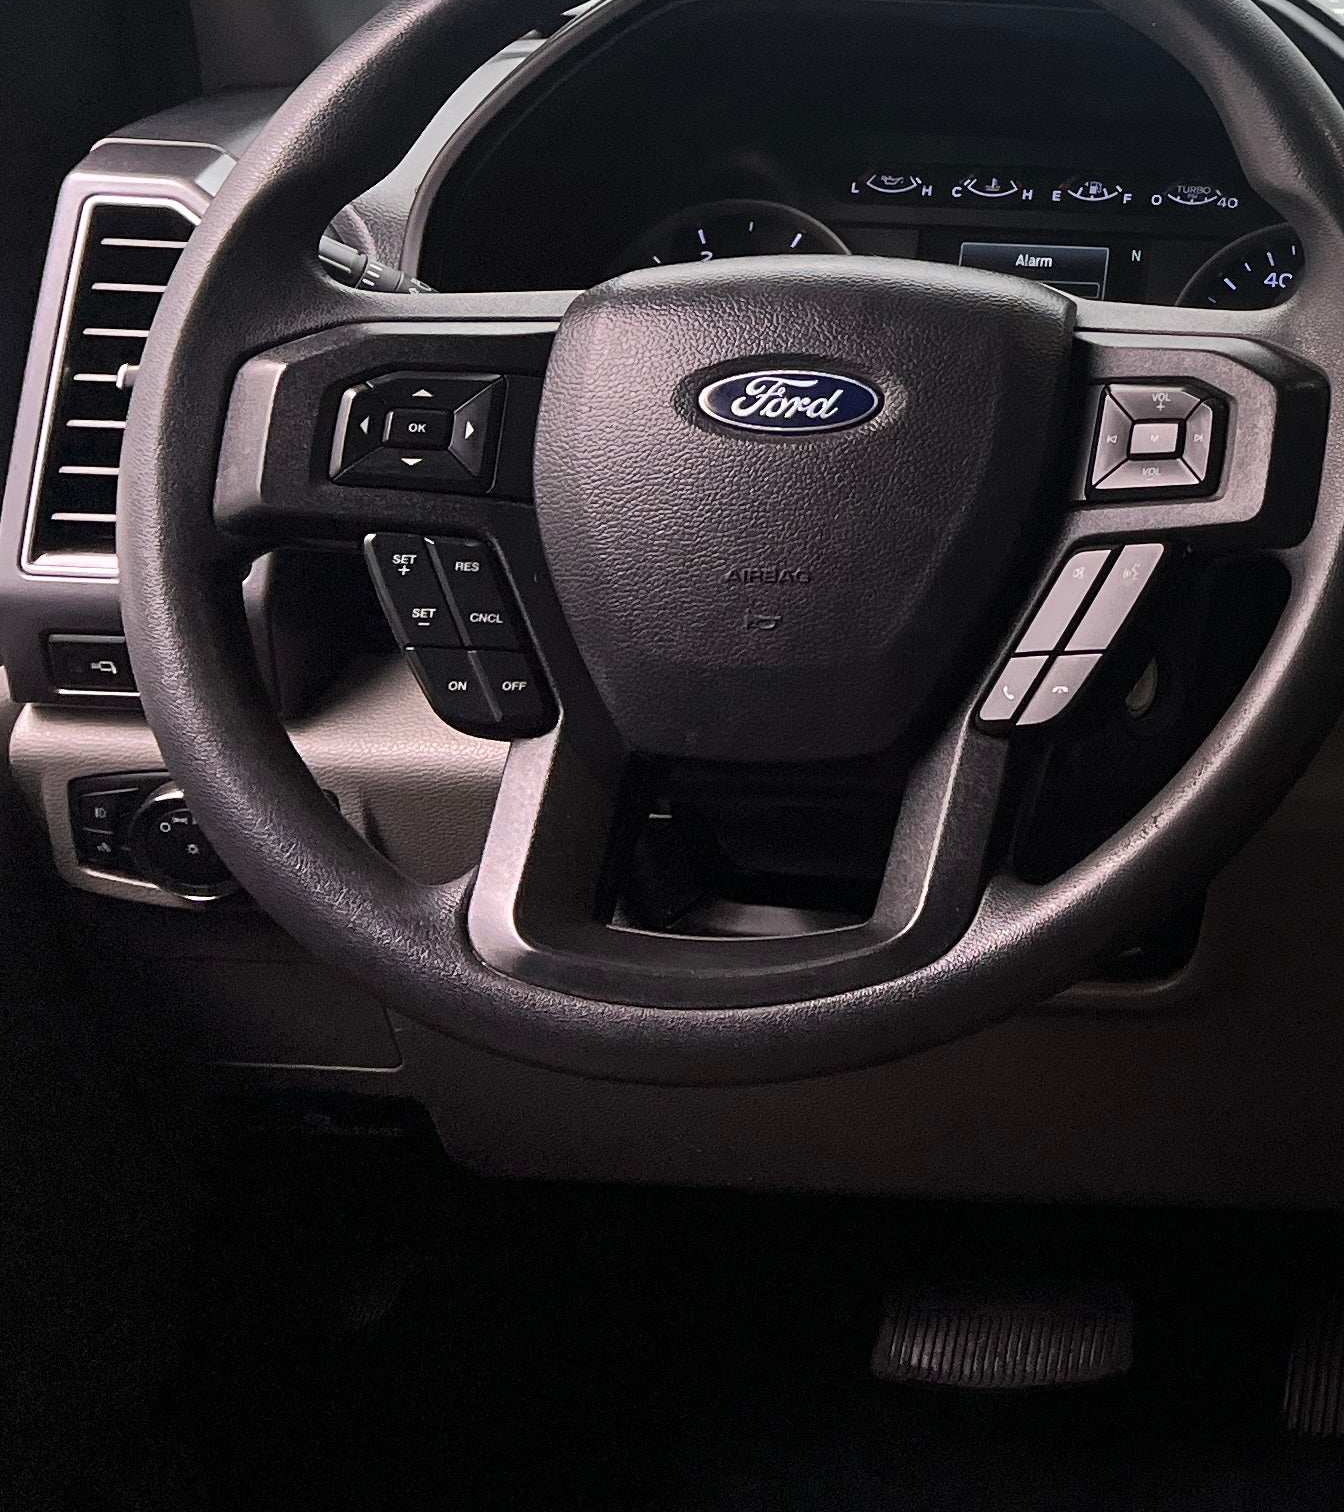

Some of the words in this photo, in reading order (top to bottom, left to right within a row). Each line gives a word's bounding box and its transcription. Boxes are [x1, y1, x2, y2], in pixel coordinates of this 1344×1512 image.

[850, 183, 860, 194] L
[921, 185, 932, 197] H
[951, 186, 962, 198] C
[1021, 188, 1033, 201] H
[1051, 190, 1061, 202] E
[1122, 192, 1132, 204] F
[1216, 197, 1239, 209] 40
[1015, 253, 1053, 268] Alarm
[1131, 249, 1142, 262] N
[731, 376, 844, 420] Ford
[1151, 393, 1172, 403] VOL
[408, 422, 427, 434] OK
[1141, 466, 1162, 477] VOL
[392, 554, 417, 565] SET
[454, 561, 480, 574] RES
[726, 569, 812, 586] AIRBAG
[411, 608, 438, 620] SET
[469, 612, 505, 625] CNCL
[448, 680, 468, 692] ON
[501, 681, 528, 692] OFF
